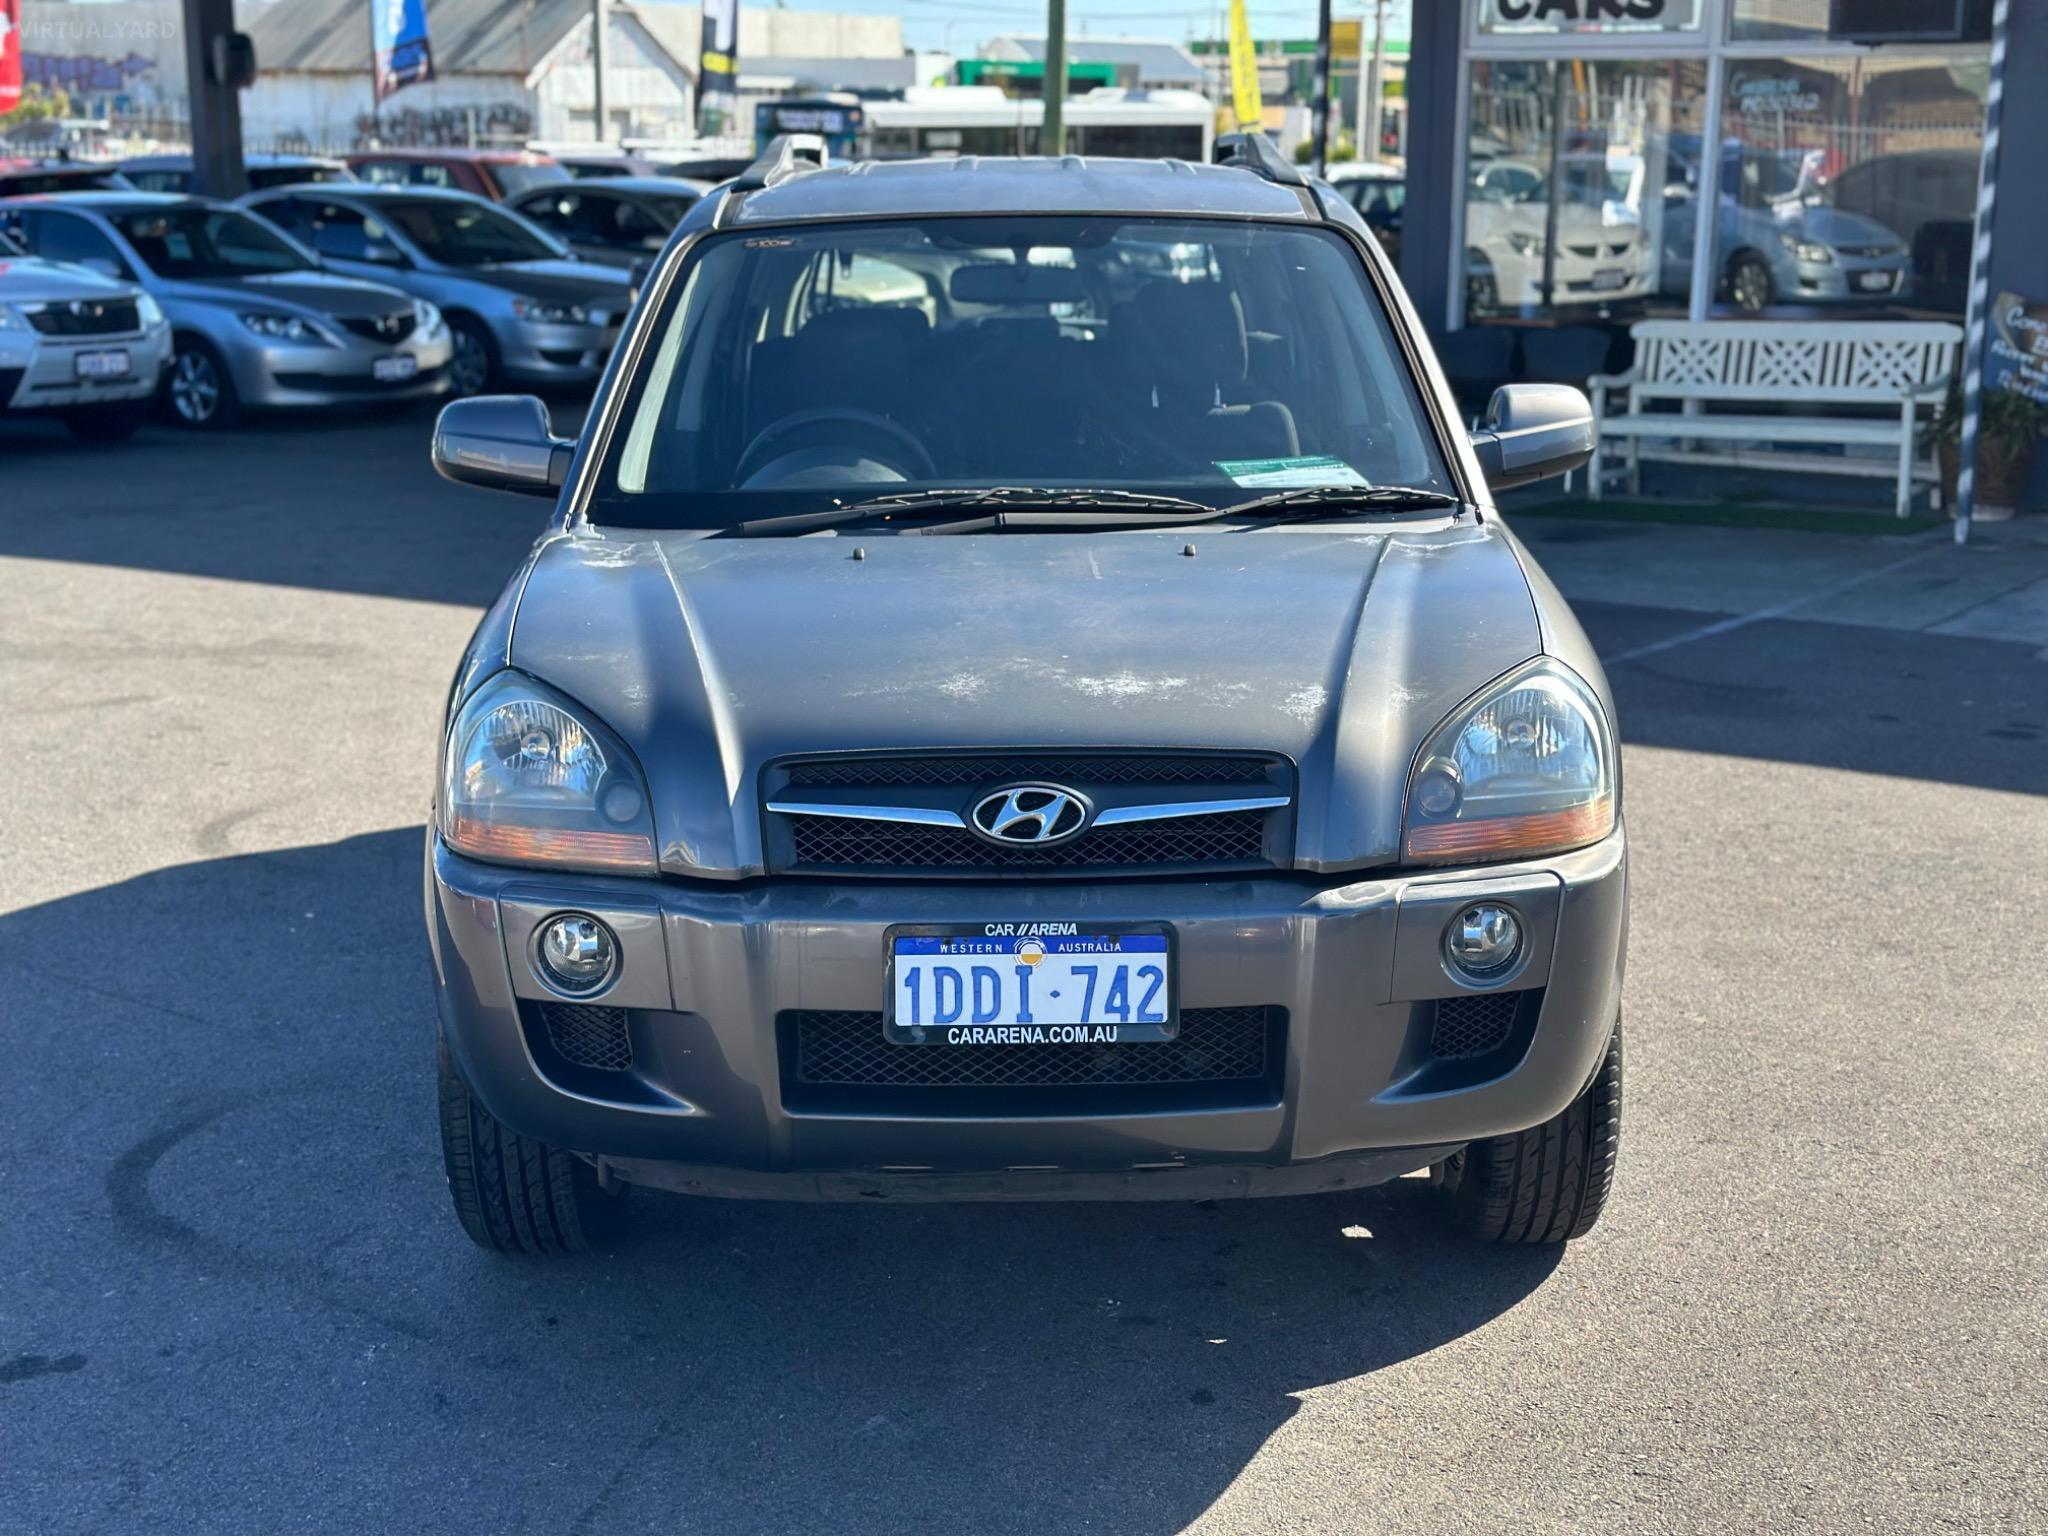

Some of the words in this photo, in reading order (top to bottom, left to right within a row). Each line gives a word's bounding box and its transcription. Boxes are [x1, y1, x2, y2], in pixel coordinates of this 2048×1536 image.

[940, 943, 1003, 954] WESTERN
[1058, 942, 1122, 953] AUSTRALIA
[948, 1026, 1118, 1045] CARARENA.COM.AU
